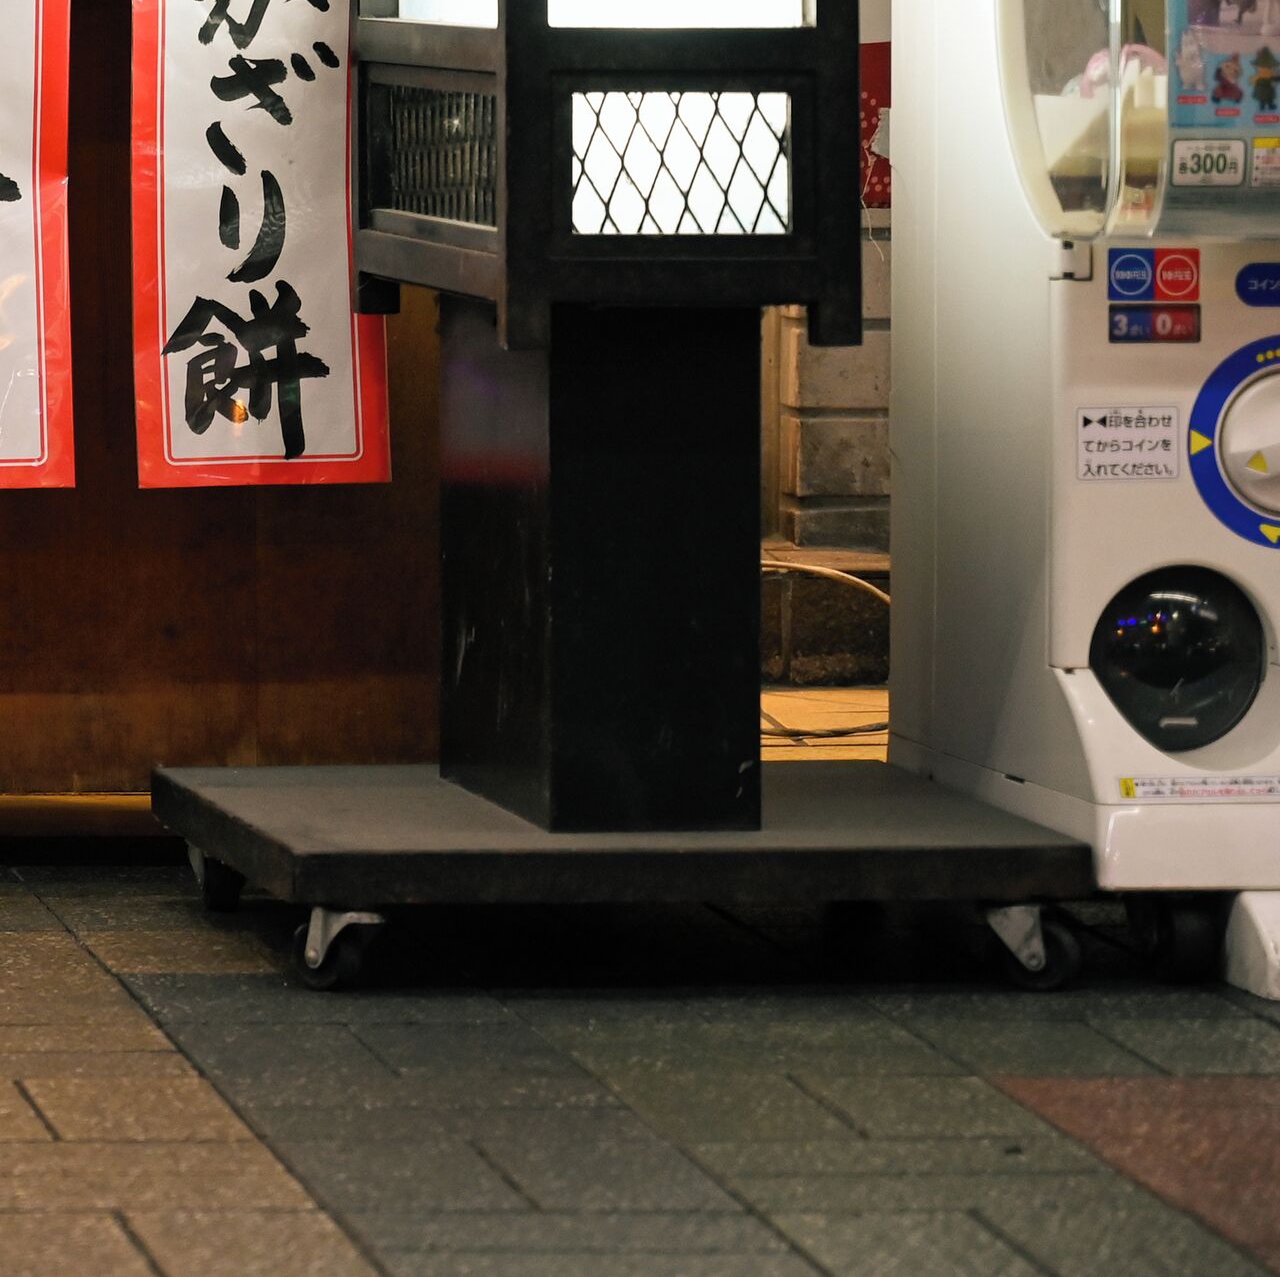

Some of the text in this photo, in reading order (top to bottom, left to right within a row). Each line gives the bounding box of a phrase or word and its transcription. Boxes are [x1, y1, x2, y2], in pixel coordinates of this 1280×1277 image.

[1083, 439, 1171, 453] てからコインを
